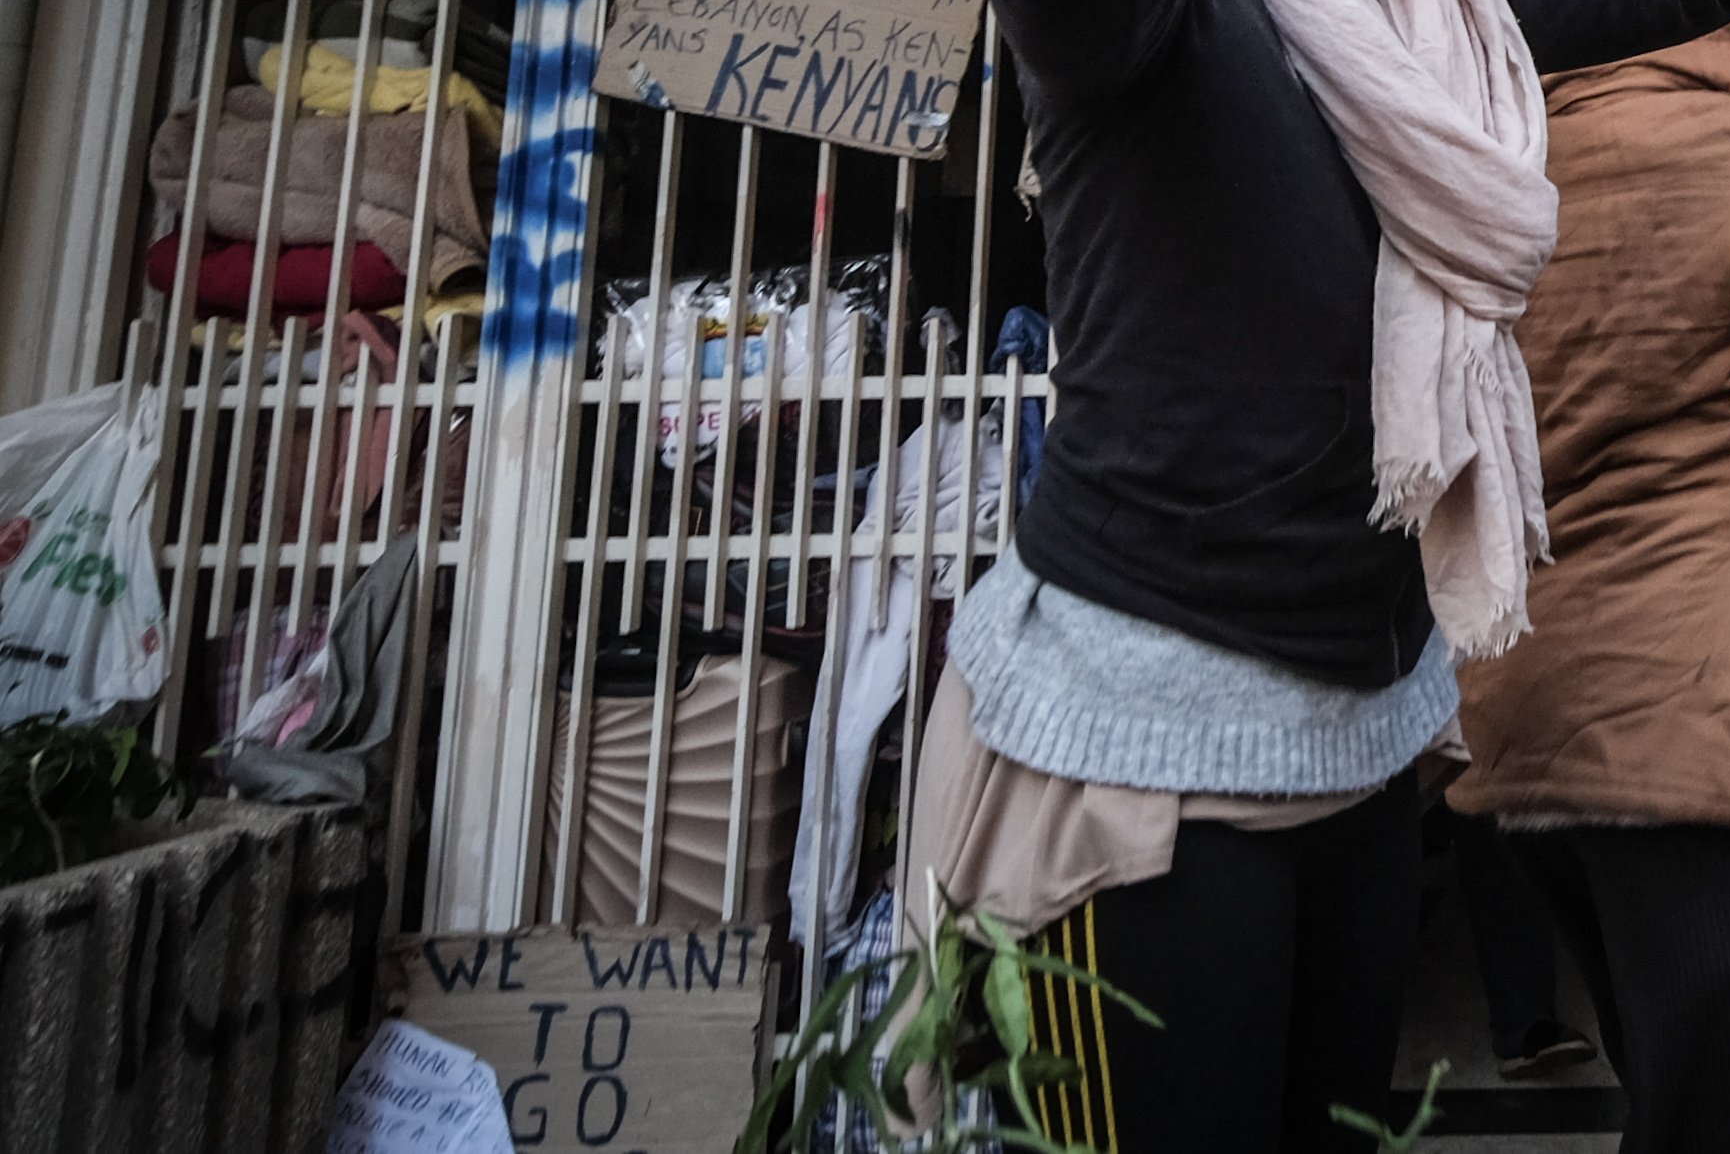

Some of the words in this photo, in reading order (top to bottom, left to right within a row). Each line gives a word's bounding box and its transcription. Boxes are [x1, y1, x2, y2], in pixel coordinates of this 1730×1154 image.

[620, 22, 707, 56] YANS
[811, 11, 867, 50] AS
[704, 33, 960, 152] KENYANS
[422, 934, 526, 993] WE
[581, 927, 758, 992] WANT
[528, 1001, 632, 1072] TO
[501, 1073, 629, 1146] GO
